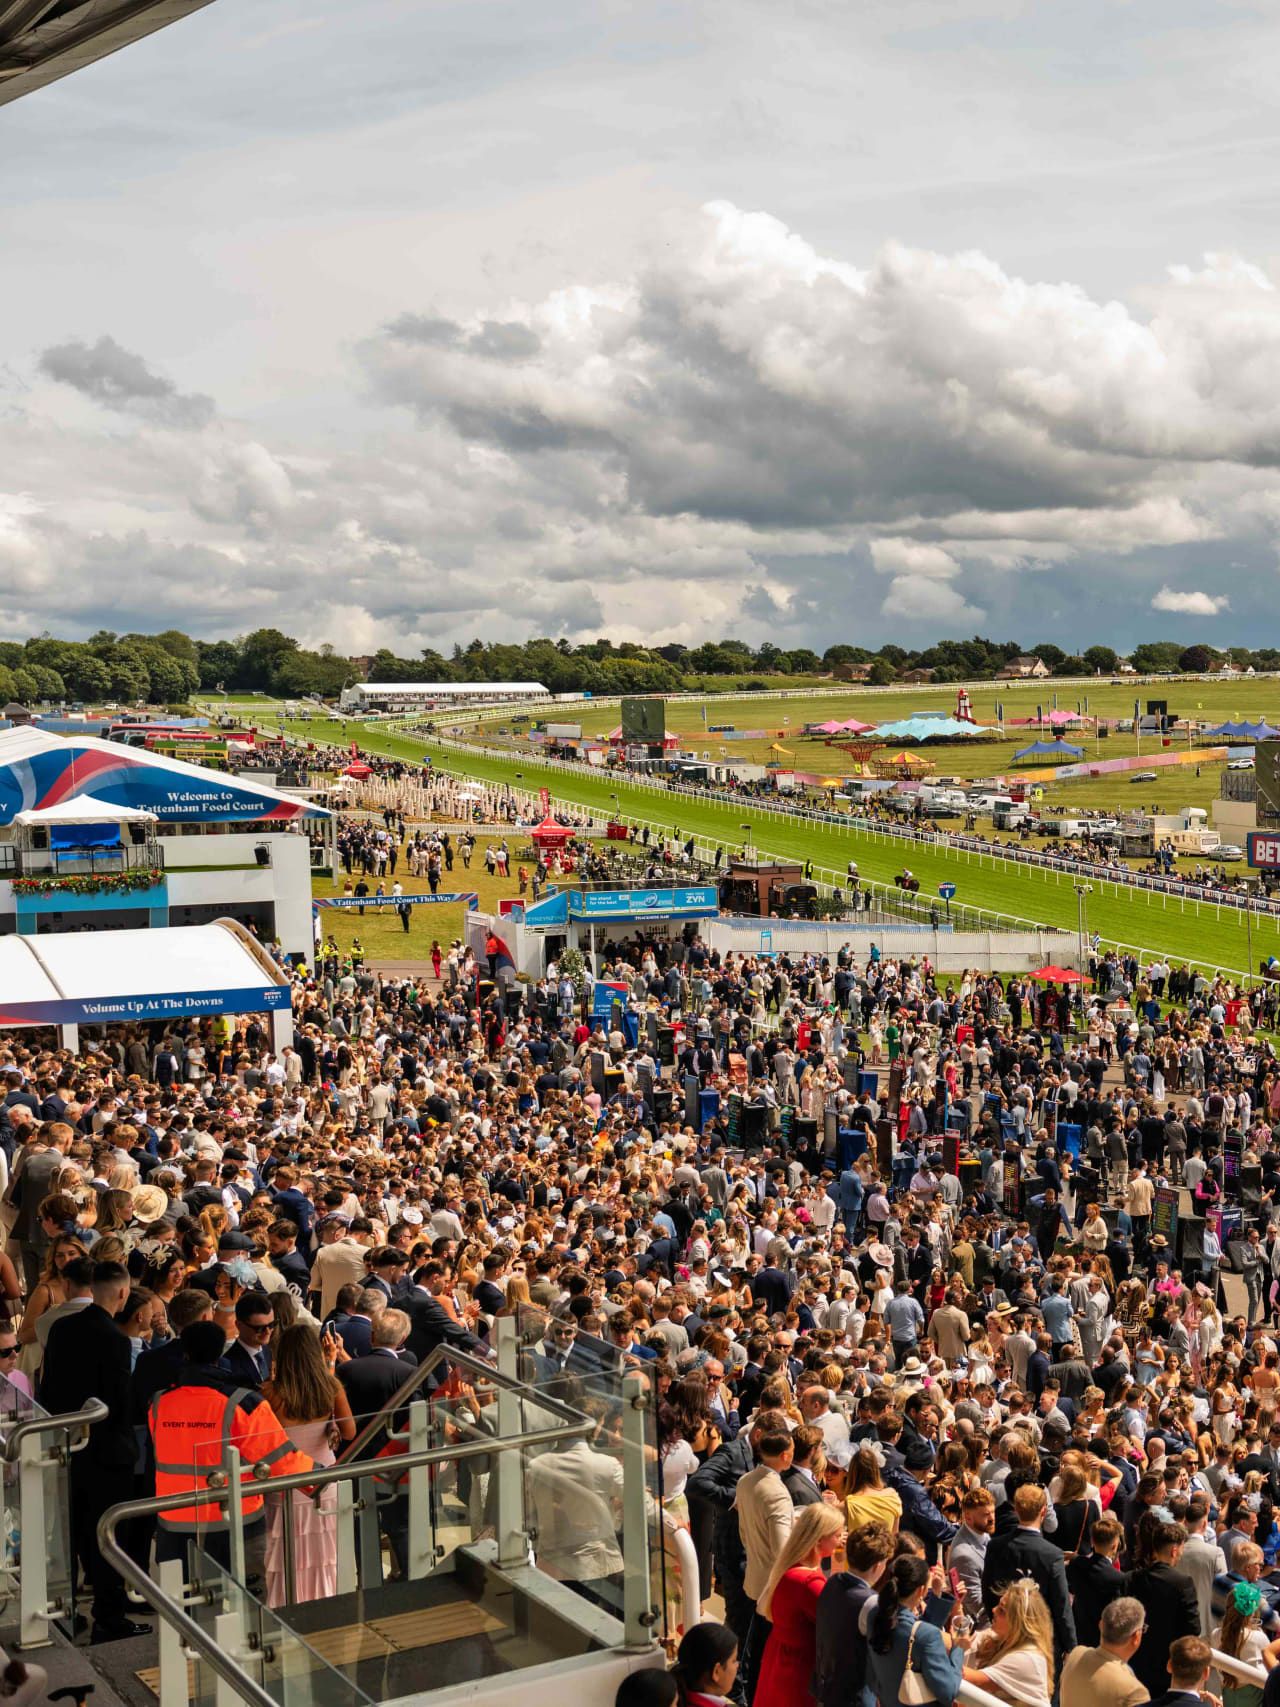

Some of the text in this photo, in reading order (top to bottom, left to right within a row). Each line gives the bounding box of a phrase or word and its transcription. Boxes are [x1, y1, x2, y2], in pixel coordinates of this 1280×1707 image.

[168, 791, 233, 802] Welcome to
[202, 802, 230, 813] Food
[232, 801, 265, 812] Court
[336, 894, 452, 907] Tattenham Food Court This Way
[686, 895, 705, 904] ZYN
[82, 996, 225, 1014] Volume Up At The Downs
[187, 1421, 217, 1429] SUPPORT
